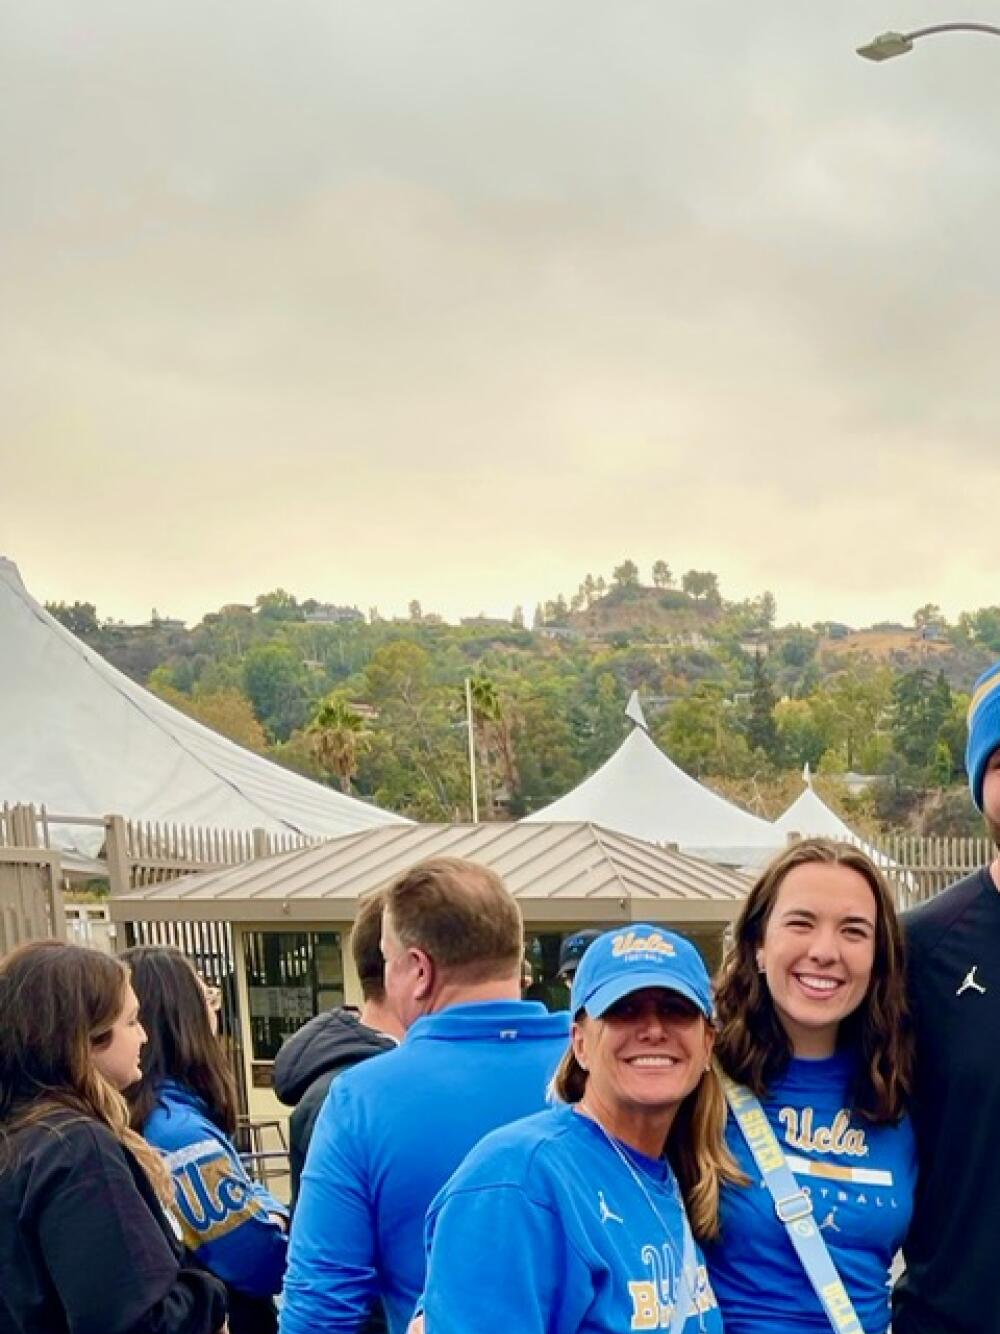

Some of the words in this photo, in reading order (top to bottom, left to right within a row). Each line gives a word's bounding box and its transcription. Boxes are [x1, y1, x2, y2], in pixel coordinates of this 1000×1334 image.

[612, 931, 676, 957] Ucla
[778, 1106, 869, 1156] Ucla
[759, 1179, 898, 1209] OTBALL
